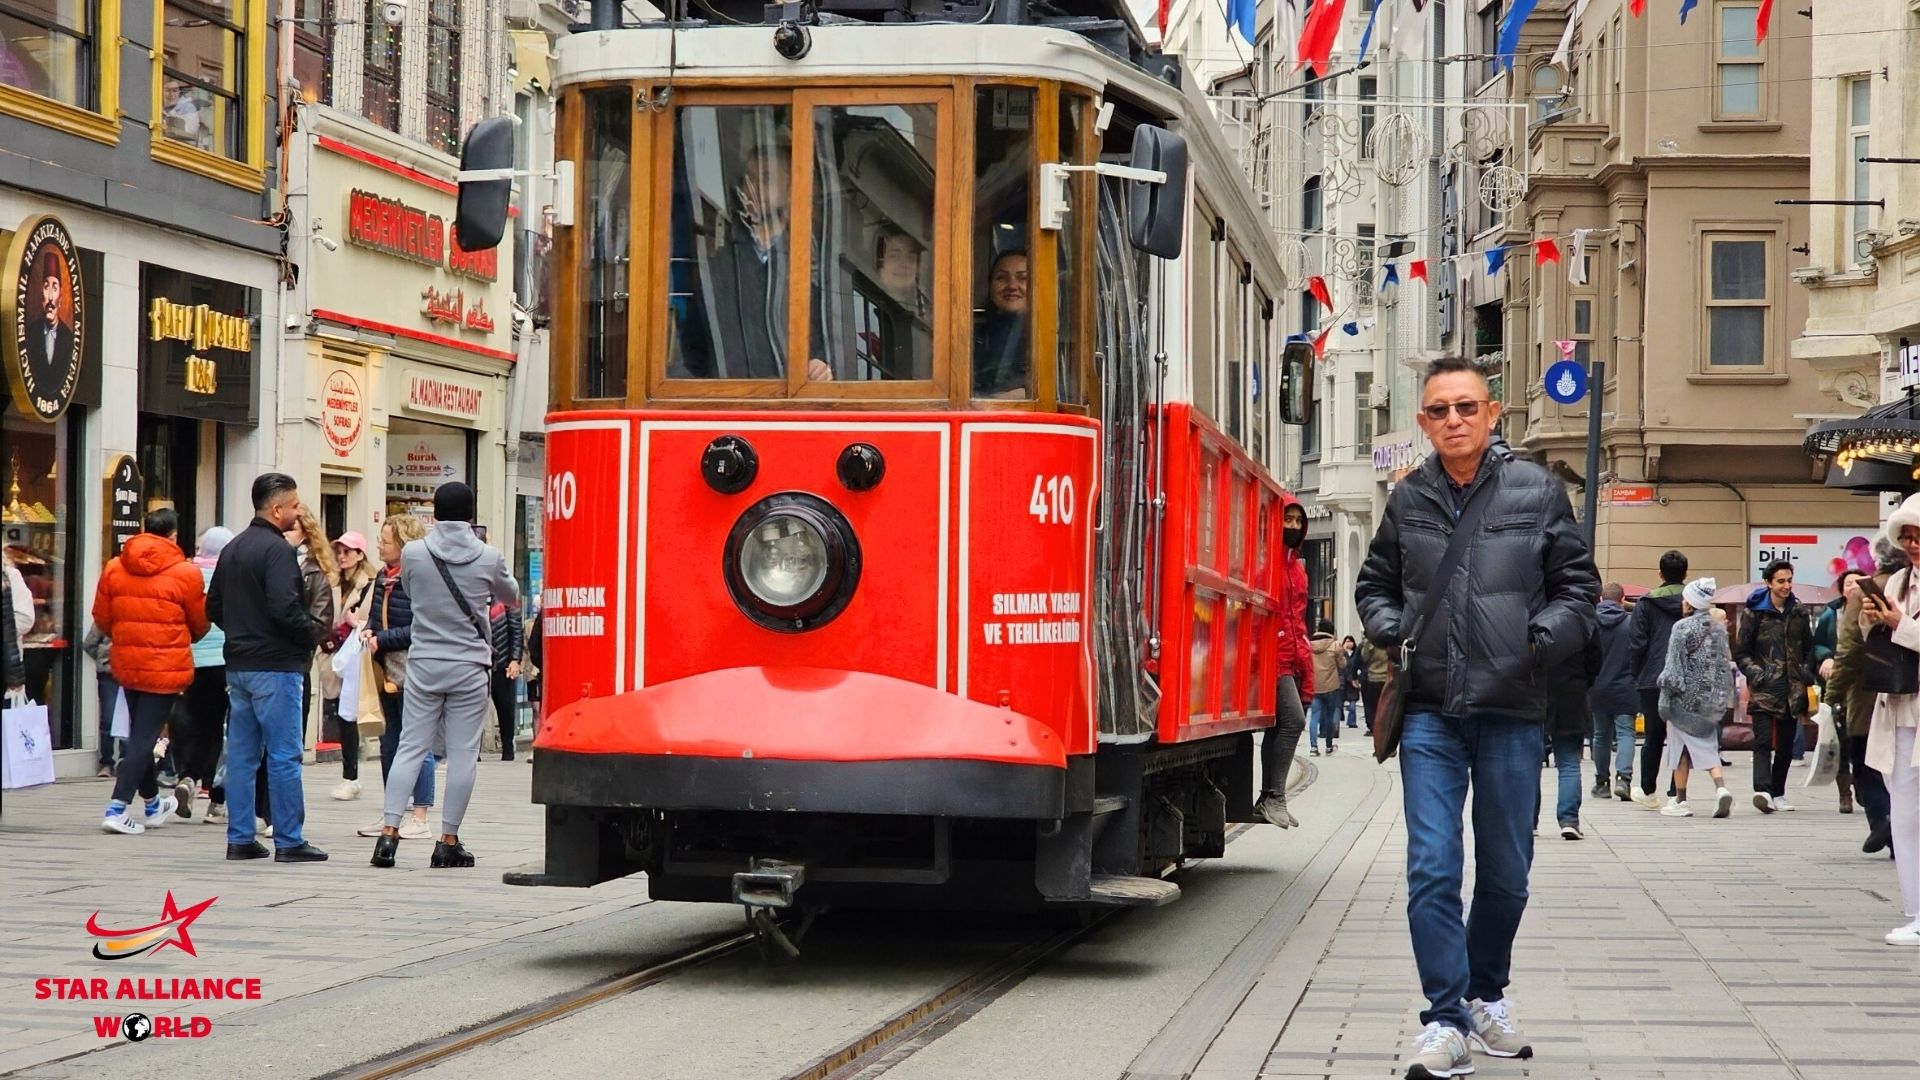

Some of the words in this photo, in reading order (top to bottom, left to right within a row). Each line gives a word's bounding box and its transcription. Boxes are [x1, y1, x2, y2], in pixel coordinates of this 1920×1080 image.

[36, 396, 59, 414] 1864
[410, 377, 418, 404] AL
[443, 383, 482, 416] RESTAURANT
[407, 453, 438, 461] Burak
[1029, 474, 1074, 525] 410
[565, 587, 606, 608] YASAK
[992, 593, 1048, 615] SILMAK
[1050, 592, 1081, 614] YASAK
[983, 623, 1003, 645] VE
[1006, 618, 1080, 645] TEHLİKELİDİR
